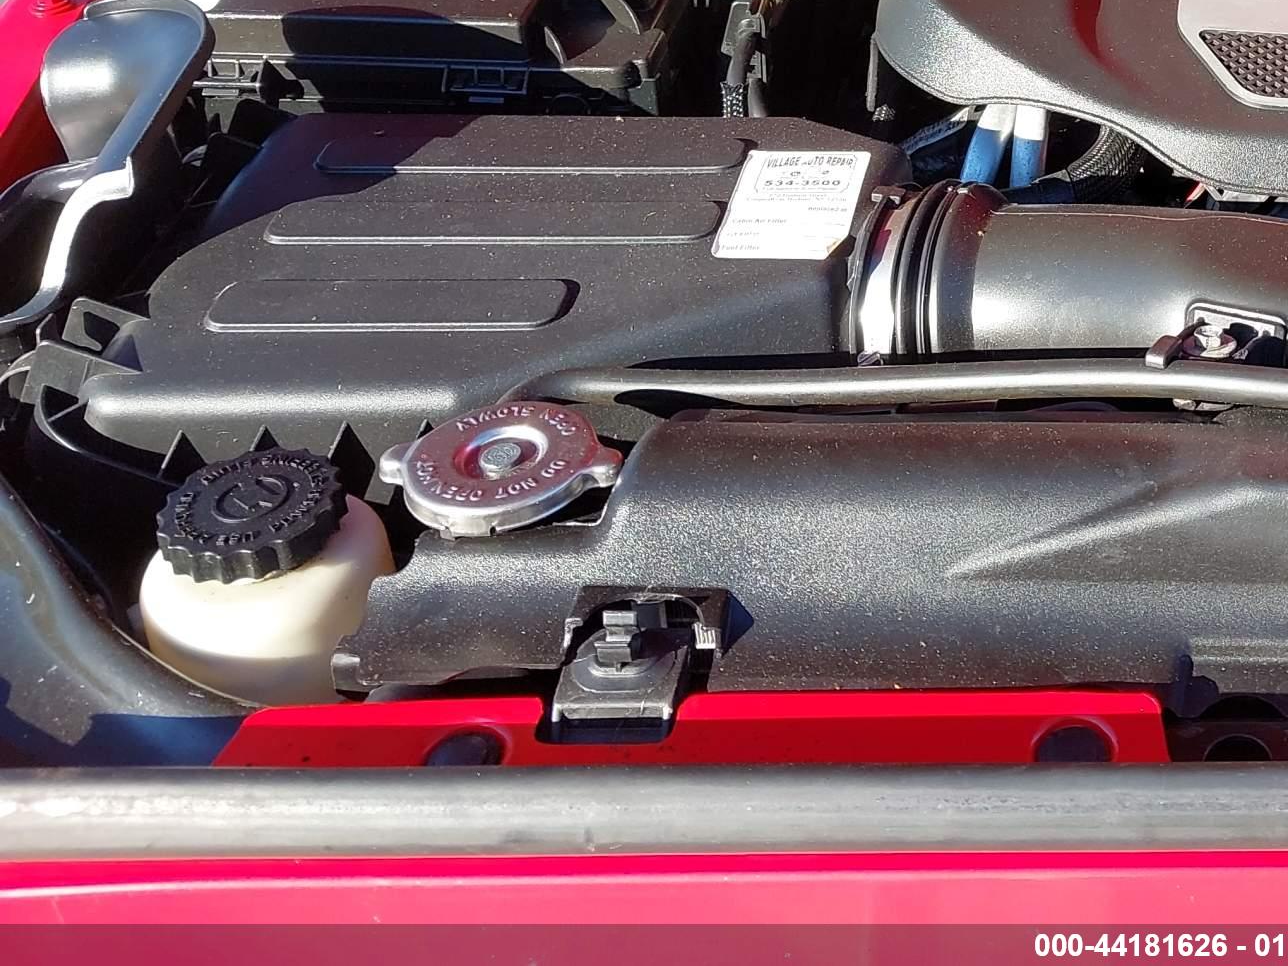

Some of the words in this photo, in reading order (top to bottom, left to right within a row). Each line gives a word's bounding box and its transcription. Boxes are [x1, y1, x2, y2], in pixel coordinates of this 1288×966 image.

[766, 156, 801, 168] VILLAGE
[826, 156, 854, 168] REPAIR
[455, 405, 536, 432] SLOWLY
[540, 458, 567, 480] DO
[431, 484, 484, 503] OPEN
[494, 475, 538, 500] NOT
